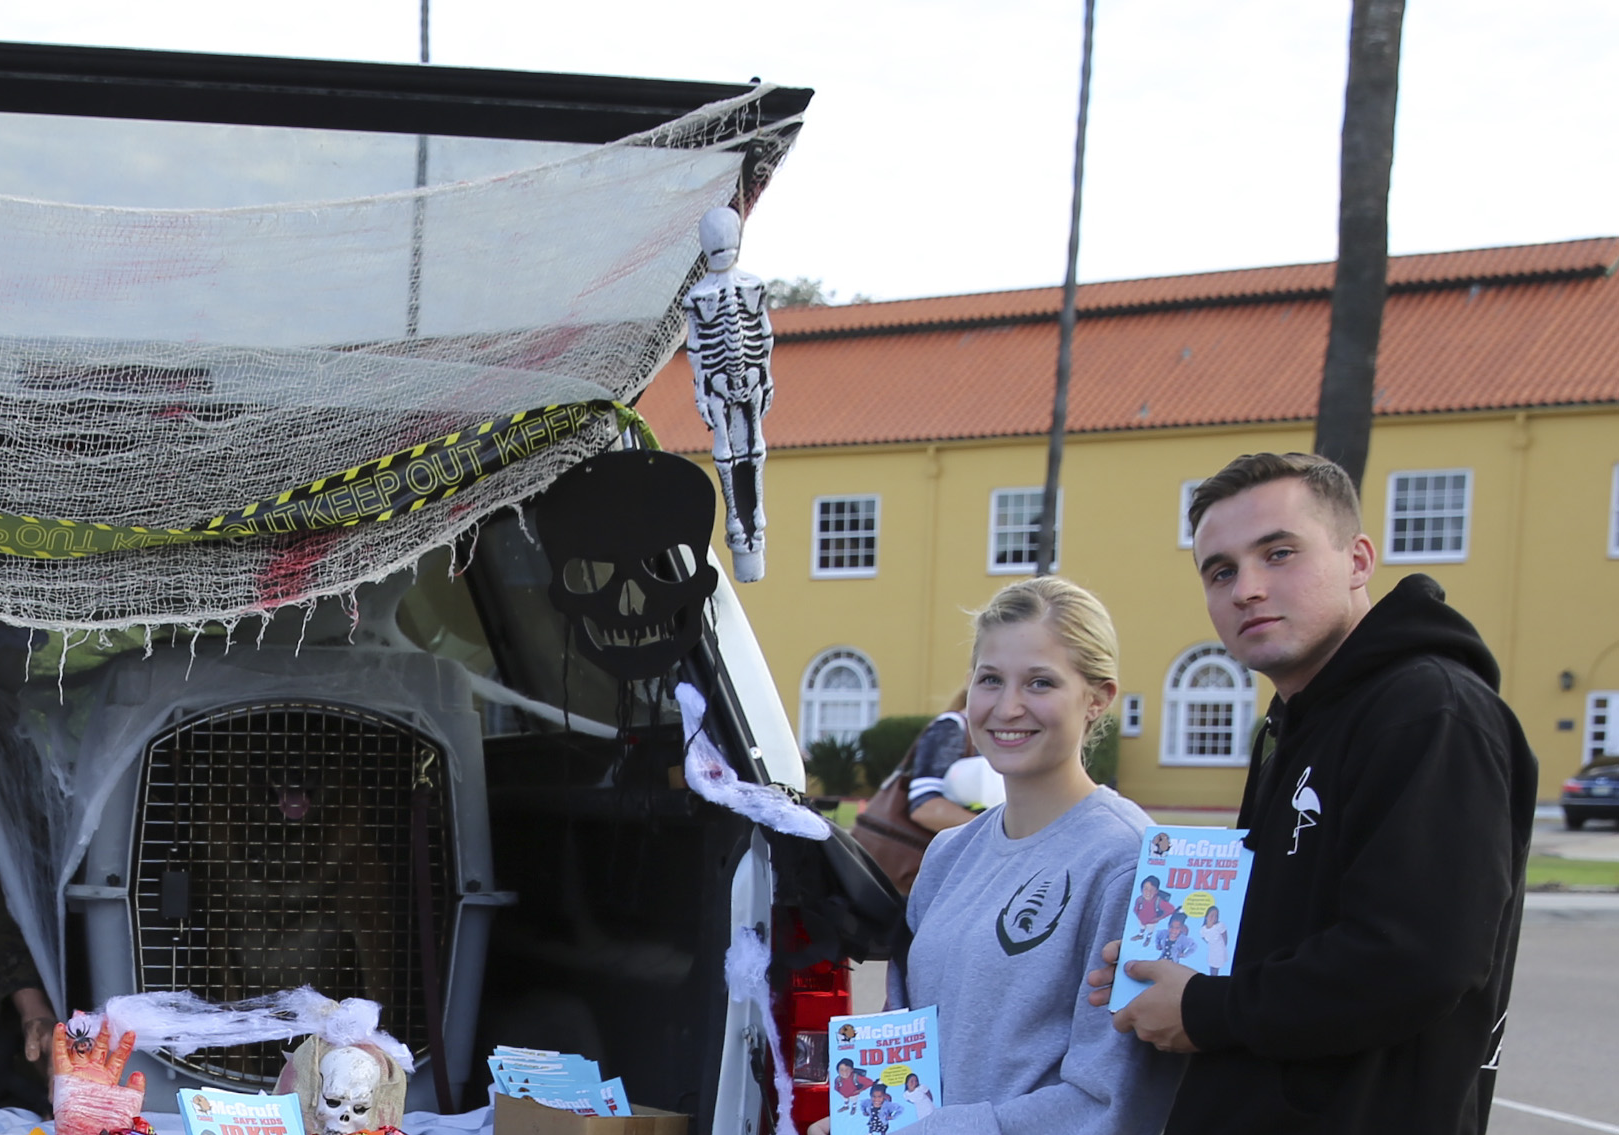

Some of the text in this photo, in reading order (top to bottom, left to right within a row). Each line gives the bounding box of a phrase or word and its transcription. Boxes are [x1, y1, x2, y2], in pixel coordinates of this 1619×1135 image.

[301, 470, 400, 529] KEEP
[405, 439, 481, 496] OUT
[1168, 838, 1243, 857] McGruff
[1187, 858, 1239, 868] SAFE KIDS
[1166, 867, 1238, 890] ID KIT
[855, 1018, 927, 1040] McGruff
[876, 1033, 926, 1047] SAFE KIDS
[859, 1041, 927, 1066] ID KIT
[210, 1100, 282, 1117] McGruff
[233, 1117, 258, 1125] SAFE
